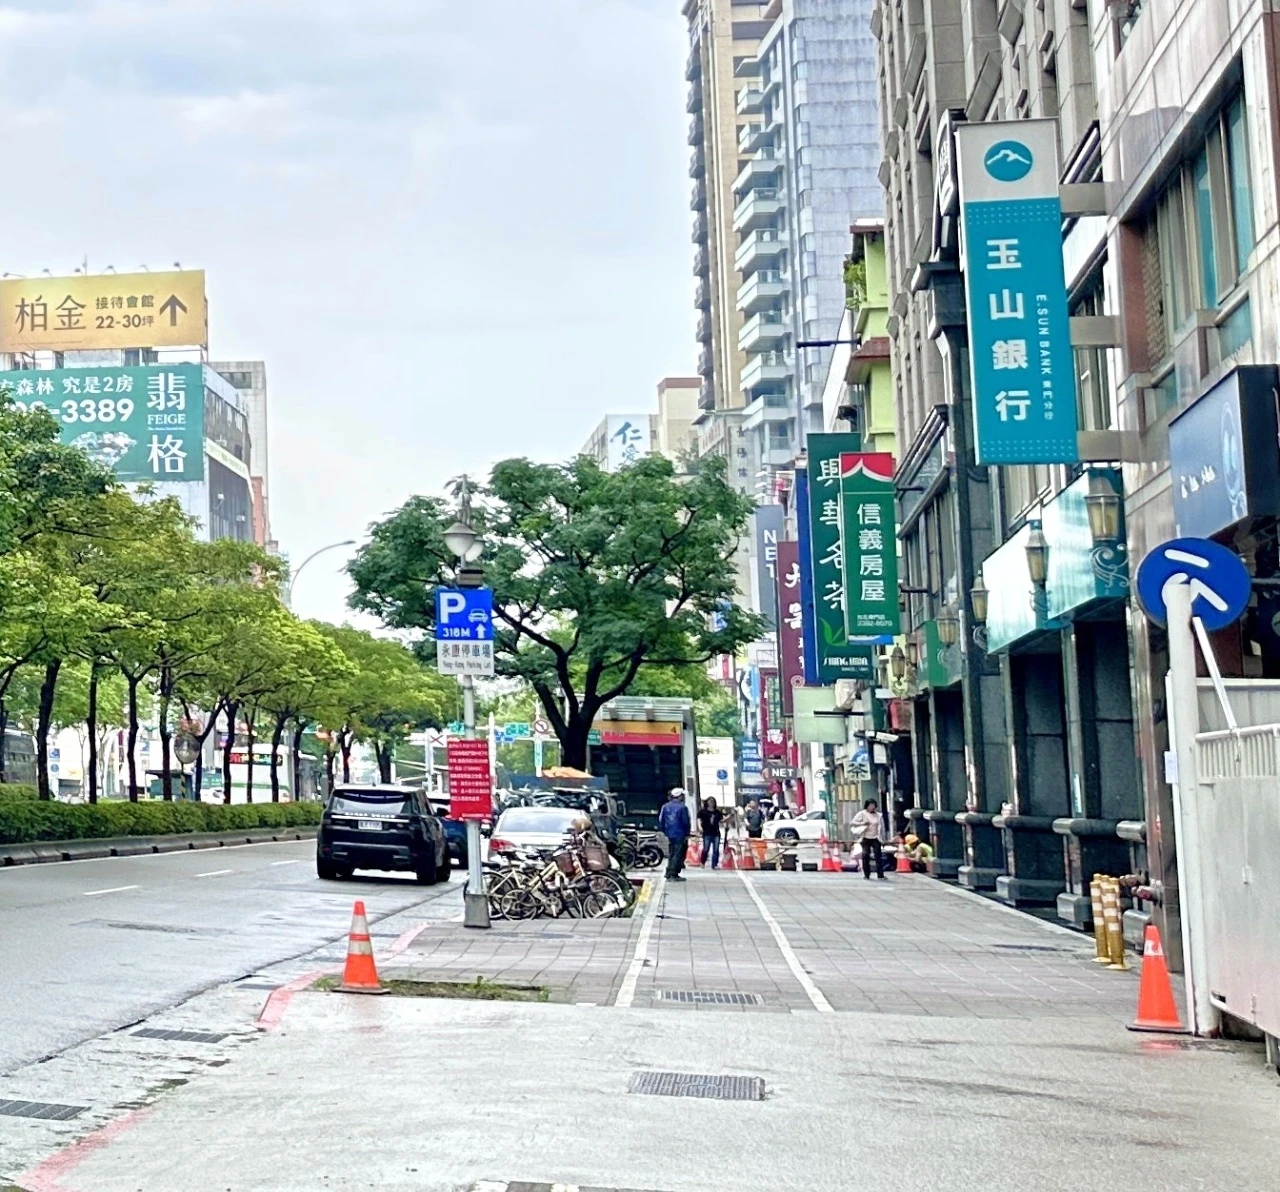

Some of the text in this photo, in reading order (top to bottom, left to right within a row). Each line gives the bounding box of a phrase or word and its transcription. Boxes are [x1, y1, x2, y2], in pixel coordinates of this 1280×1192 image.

[14, 294, 155, 333] 柏金 接待會館
[95, 314, 155, 330] 22-30坪
[986, 238, 1031, 421] 玉山銀行
[1036, 294, 1050, 335] E.SUN
[1039, 341, 1052, 375] BANK
[62, 374, 134, 395] 究是2房
[147, 372, 187, 411] 翡
[147, 413, 187, 425] FEIGE
[147, 434, 188, 473] 格
[857, 503, 886, 601] 信義房屋
[440, 592, 466, 624] P
[442, 627, 470, 637] 318M
[771, 768, 794, 777] NET
